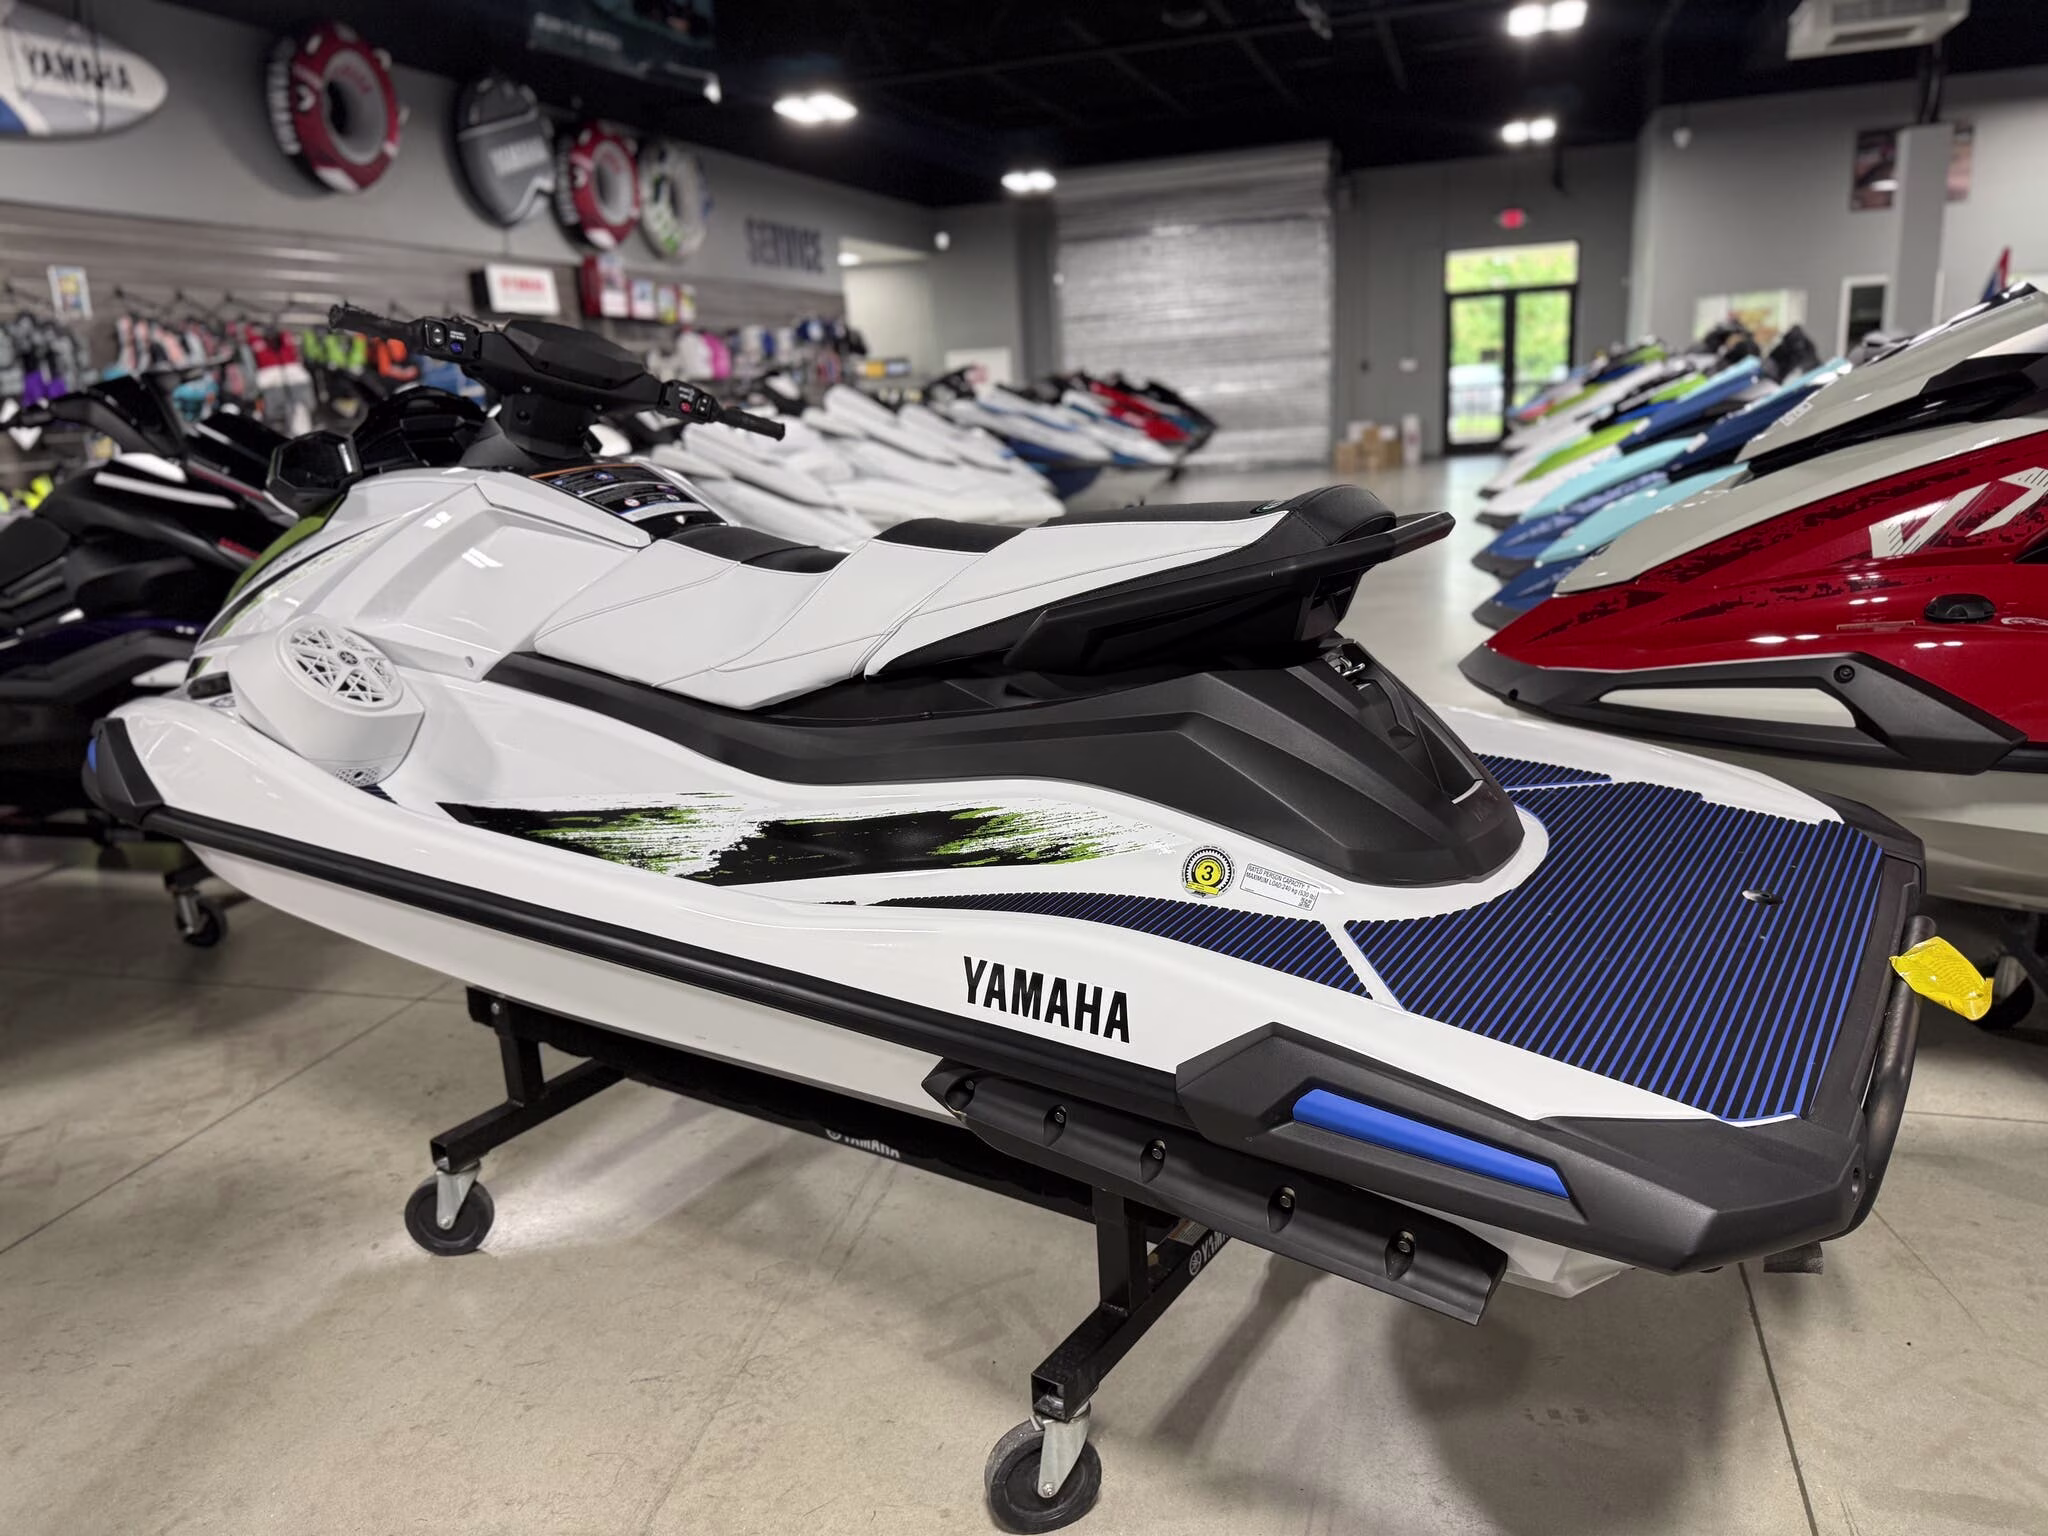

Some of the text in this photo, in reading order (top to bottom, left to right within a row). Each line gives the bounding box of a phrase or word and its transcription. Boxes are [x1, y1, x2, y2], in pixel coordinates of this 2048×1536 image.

[1202, 865, 1214, 881] 3
[1246, 871, 1269, 884] MAXIMUM
[1263, 870, 1282, 881] PERSON
[963, 955, 1130, 1044] YAMAHA
